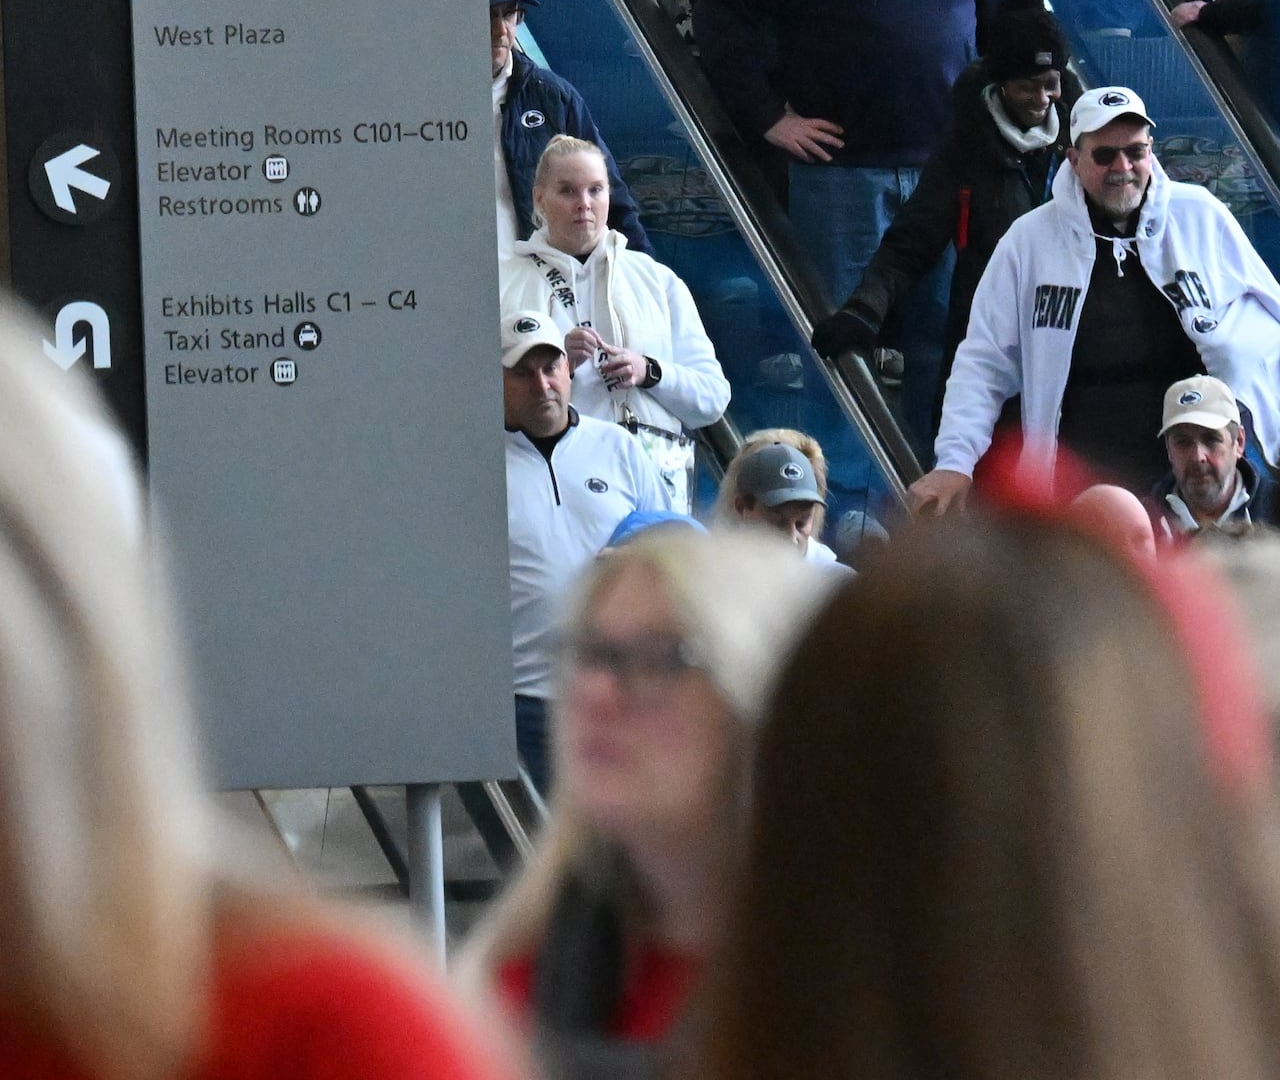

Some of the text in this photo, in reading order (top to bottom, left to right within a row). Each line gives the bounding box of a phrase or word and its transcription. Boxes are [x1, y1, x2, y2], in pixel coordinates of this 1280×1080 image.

[154, 24, 285, 46] West Plaza
[156, 127, 254, 152] Meeting
[264, 125, 342, 146] Rooms
[157, 162, 252, 183] Elevator
[159, 197, 283, 217] Restrooms
[162, 294, 254, 317] Exhibits
[265, 293, 317, 314] Halls
[327, 292, 352, 312] C1
[388, 290, 417, 311] C4
[165, 327, 284, 350] Taxi Stand
[165, 364, 259, 385] Elevator
